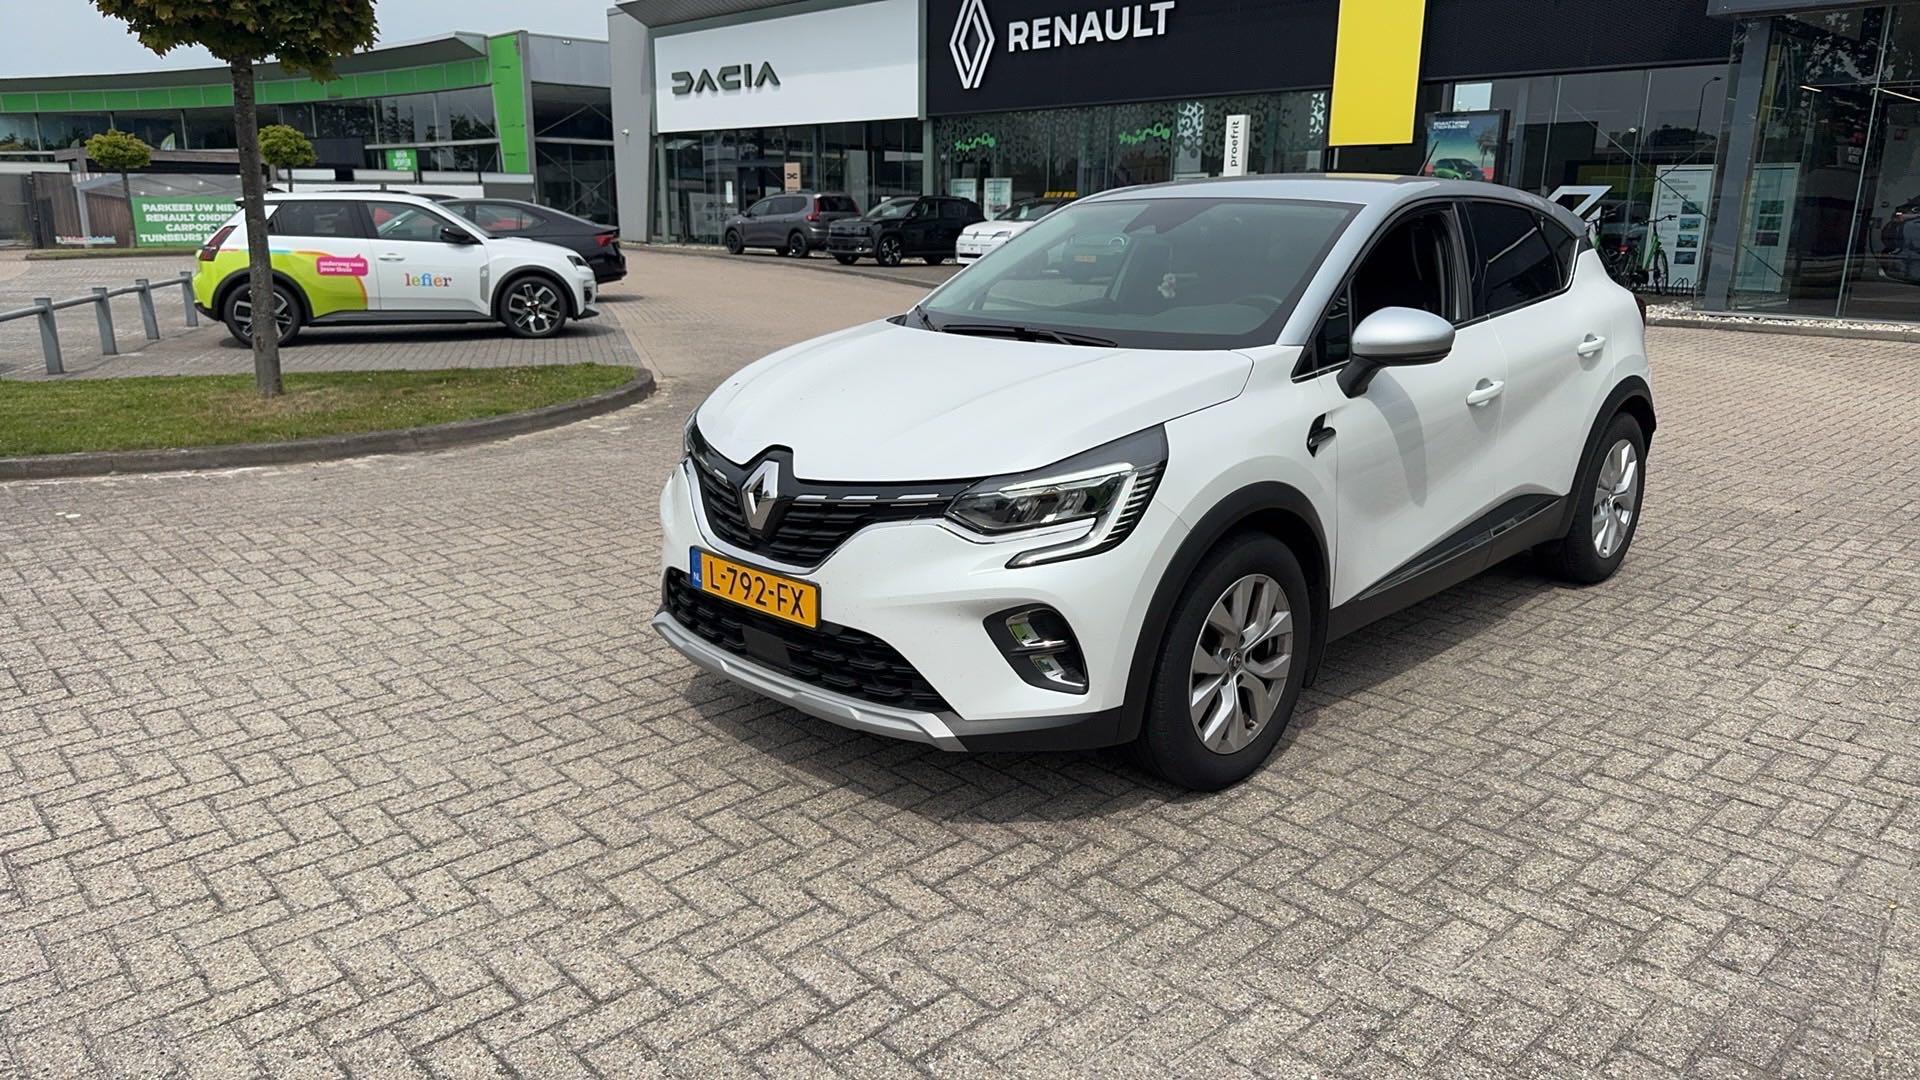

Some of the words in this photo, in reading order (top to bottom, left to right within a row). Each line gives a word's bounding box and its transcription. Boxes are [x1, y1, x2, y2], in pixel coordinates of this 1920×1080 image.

[1008, 1, 1175, 52] RENAULT
[672, 61, 780, 95] DACIA
[1230, 120, 1240, 168] proefrit
[142, 203, 193, 212] PARKEER
[195, 203, 214, 212] UW
[216, 202, 242, 212] NIEU
[145, 213, 195, 222] RENAULT
[197, 213, 232, 222] ONDE
[140, 233, 203, 243] TUINBEURS
[405, 272, 452, 287] lefier
[709, 560, 805, 619] L-792-FX
